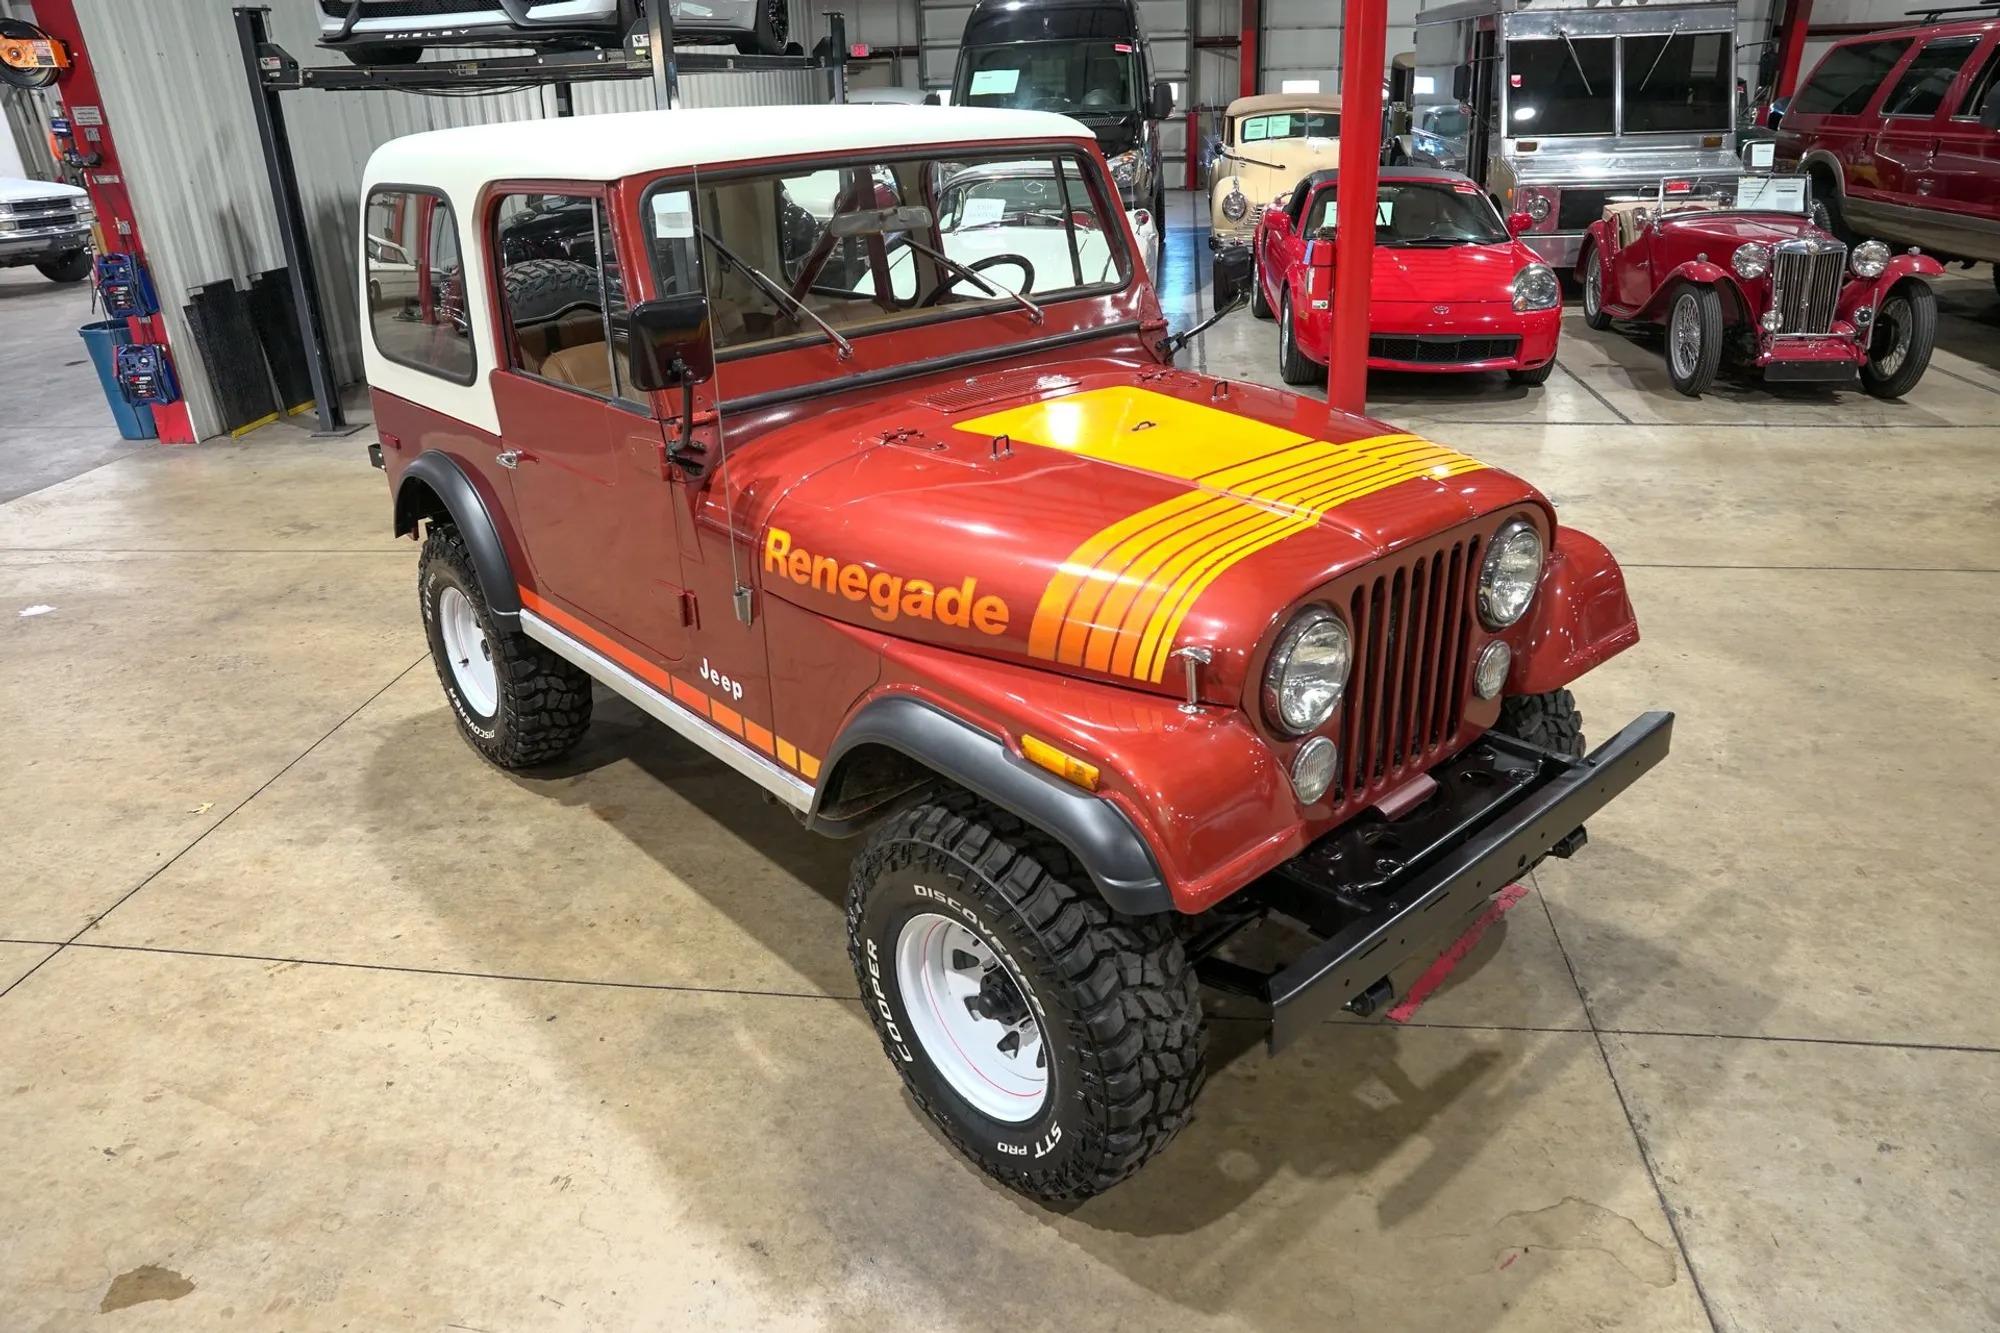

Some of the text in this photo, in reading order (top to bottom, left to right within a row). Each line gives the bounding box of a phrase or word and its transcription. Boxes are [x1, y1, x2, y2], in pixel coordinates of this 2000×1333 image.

[764, 527, 1009, 635] Renegade
[448, 687, 495, 739] DISCOVERER
[699, 657, 743, 701] Jeep
[913, 884, 1046, 1018] DISCOVERER
[866, 938, 913, 1063] COOPER
[997, 1121, 1063, 1159] STT PRO
